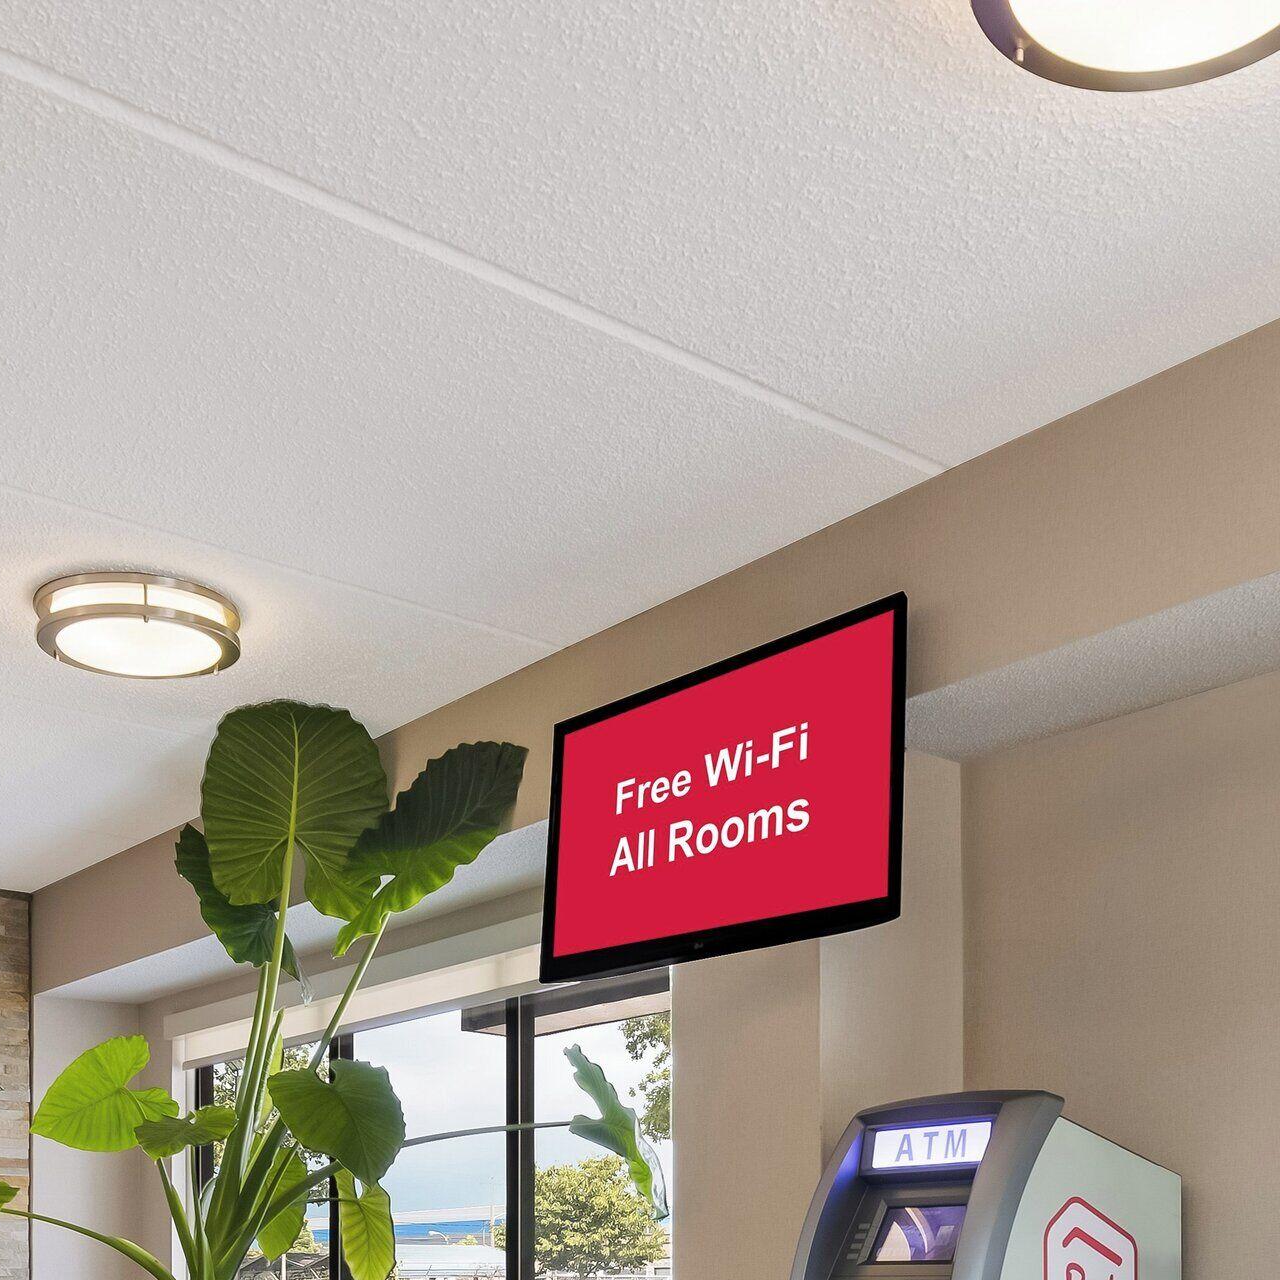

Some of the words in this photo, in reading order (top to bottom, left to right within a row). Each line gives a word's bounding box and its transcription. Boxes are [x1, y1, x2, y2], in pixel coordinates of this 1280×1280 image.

[615, 769, 692, 815] Free
[704, 721, 809, 788] Wi-Fi
[609, 829, 656, 877] All
[668, 798, 811, 863] Rooms
[895, 1129, 967, 1162] ATM
